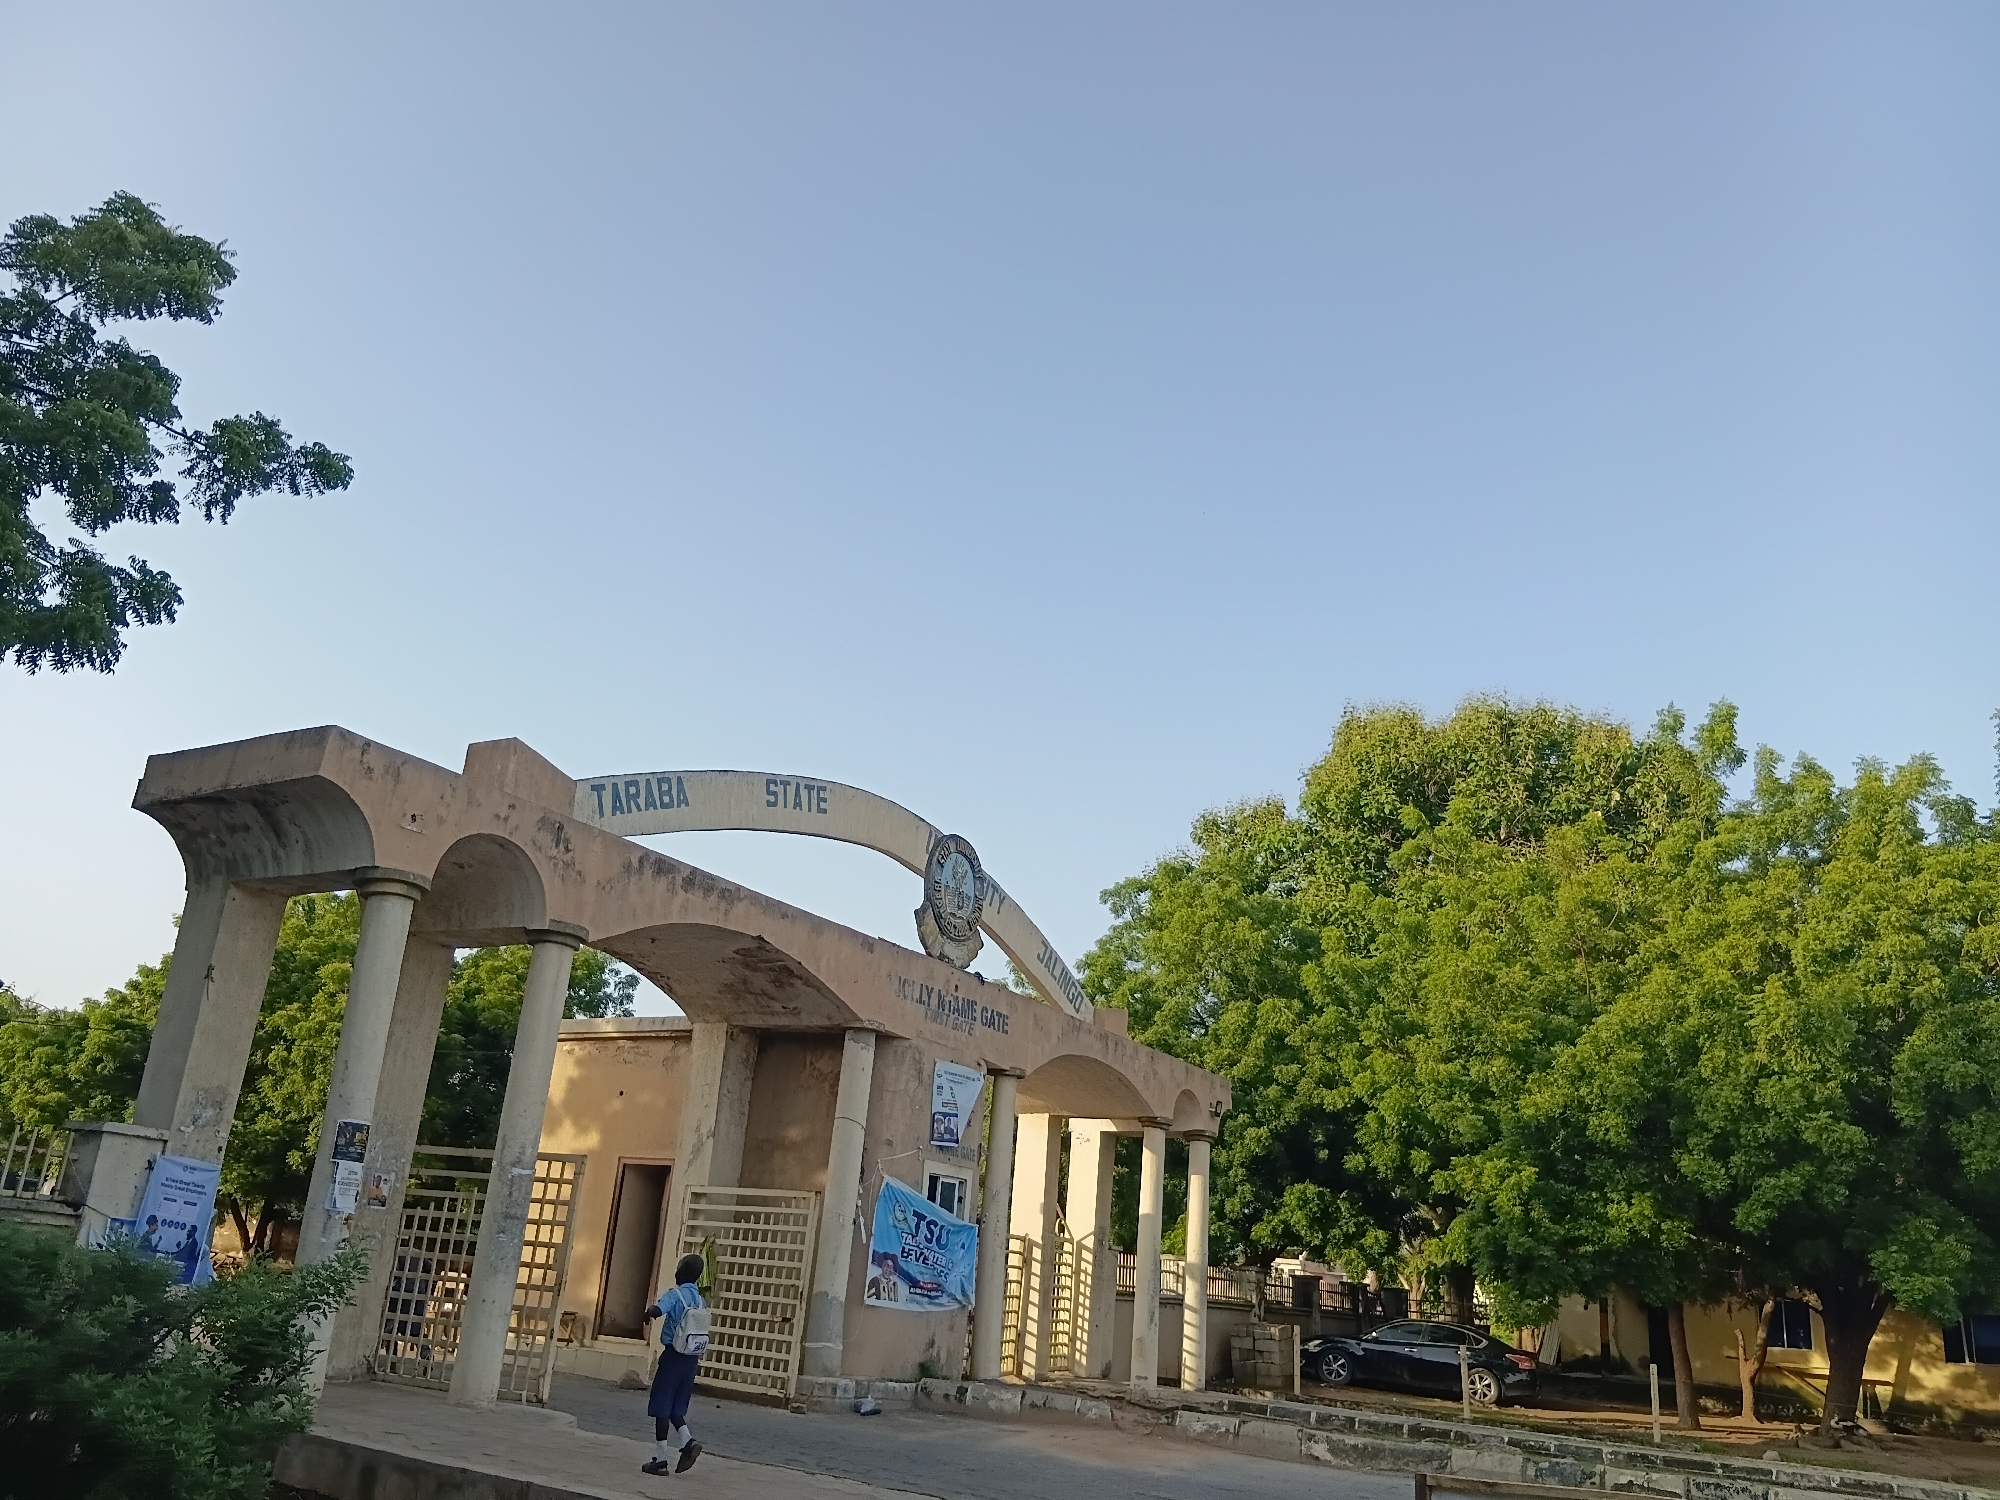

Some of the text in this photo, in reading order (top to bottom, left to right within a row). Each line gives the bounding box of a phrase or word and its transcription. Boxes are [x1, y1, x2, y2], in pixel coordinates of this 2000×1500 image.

[591, 776, 828, 819] TARABA STATE
[1036, 940, 1085, 1015] JALINGO
[951, 1016, 976, 1037] GATE
[980, 1005, 1009, 1035] GATE
[911, 1208, 952, 1251] TSU
